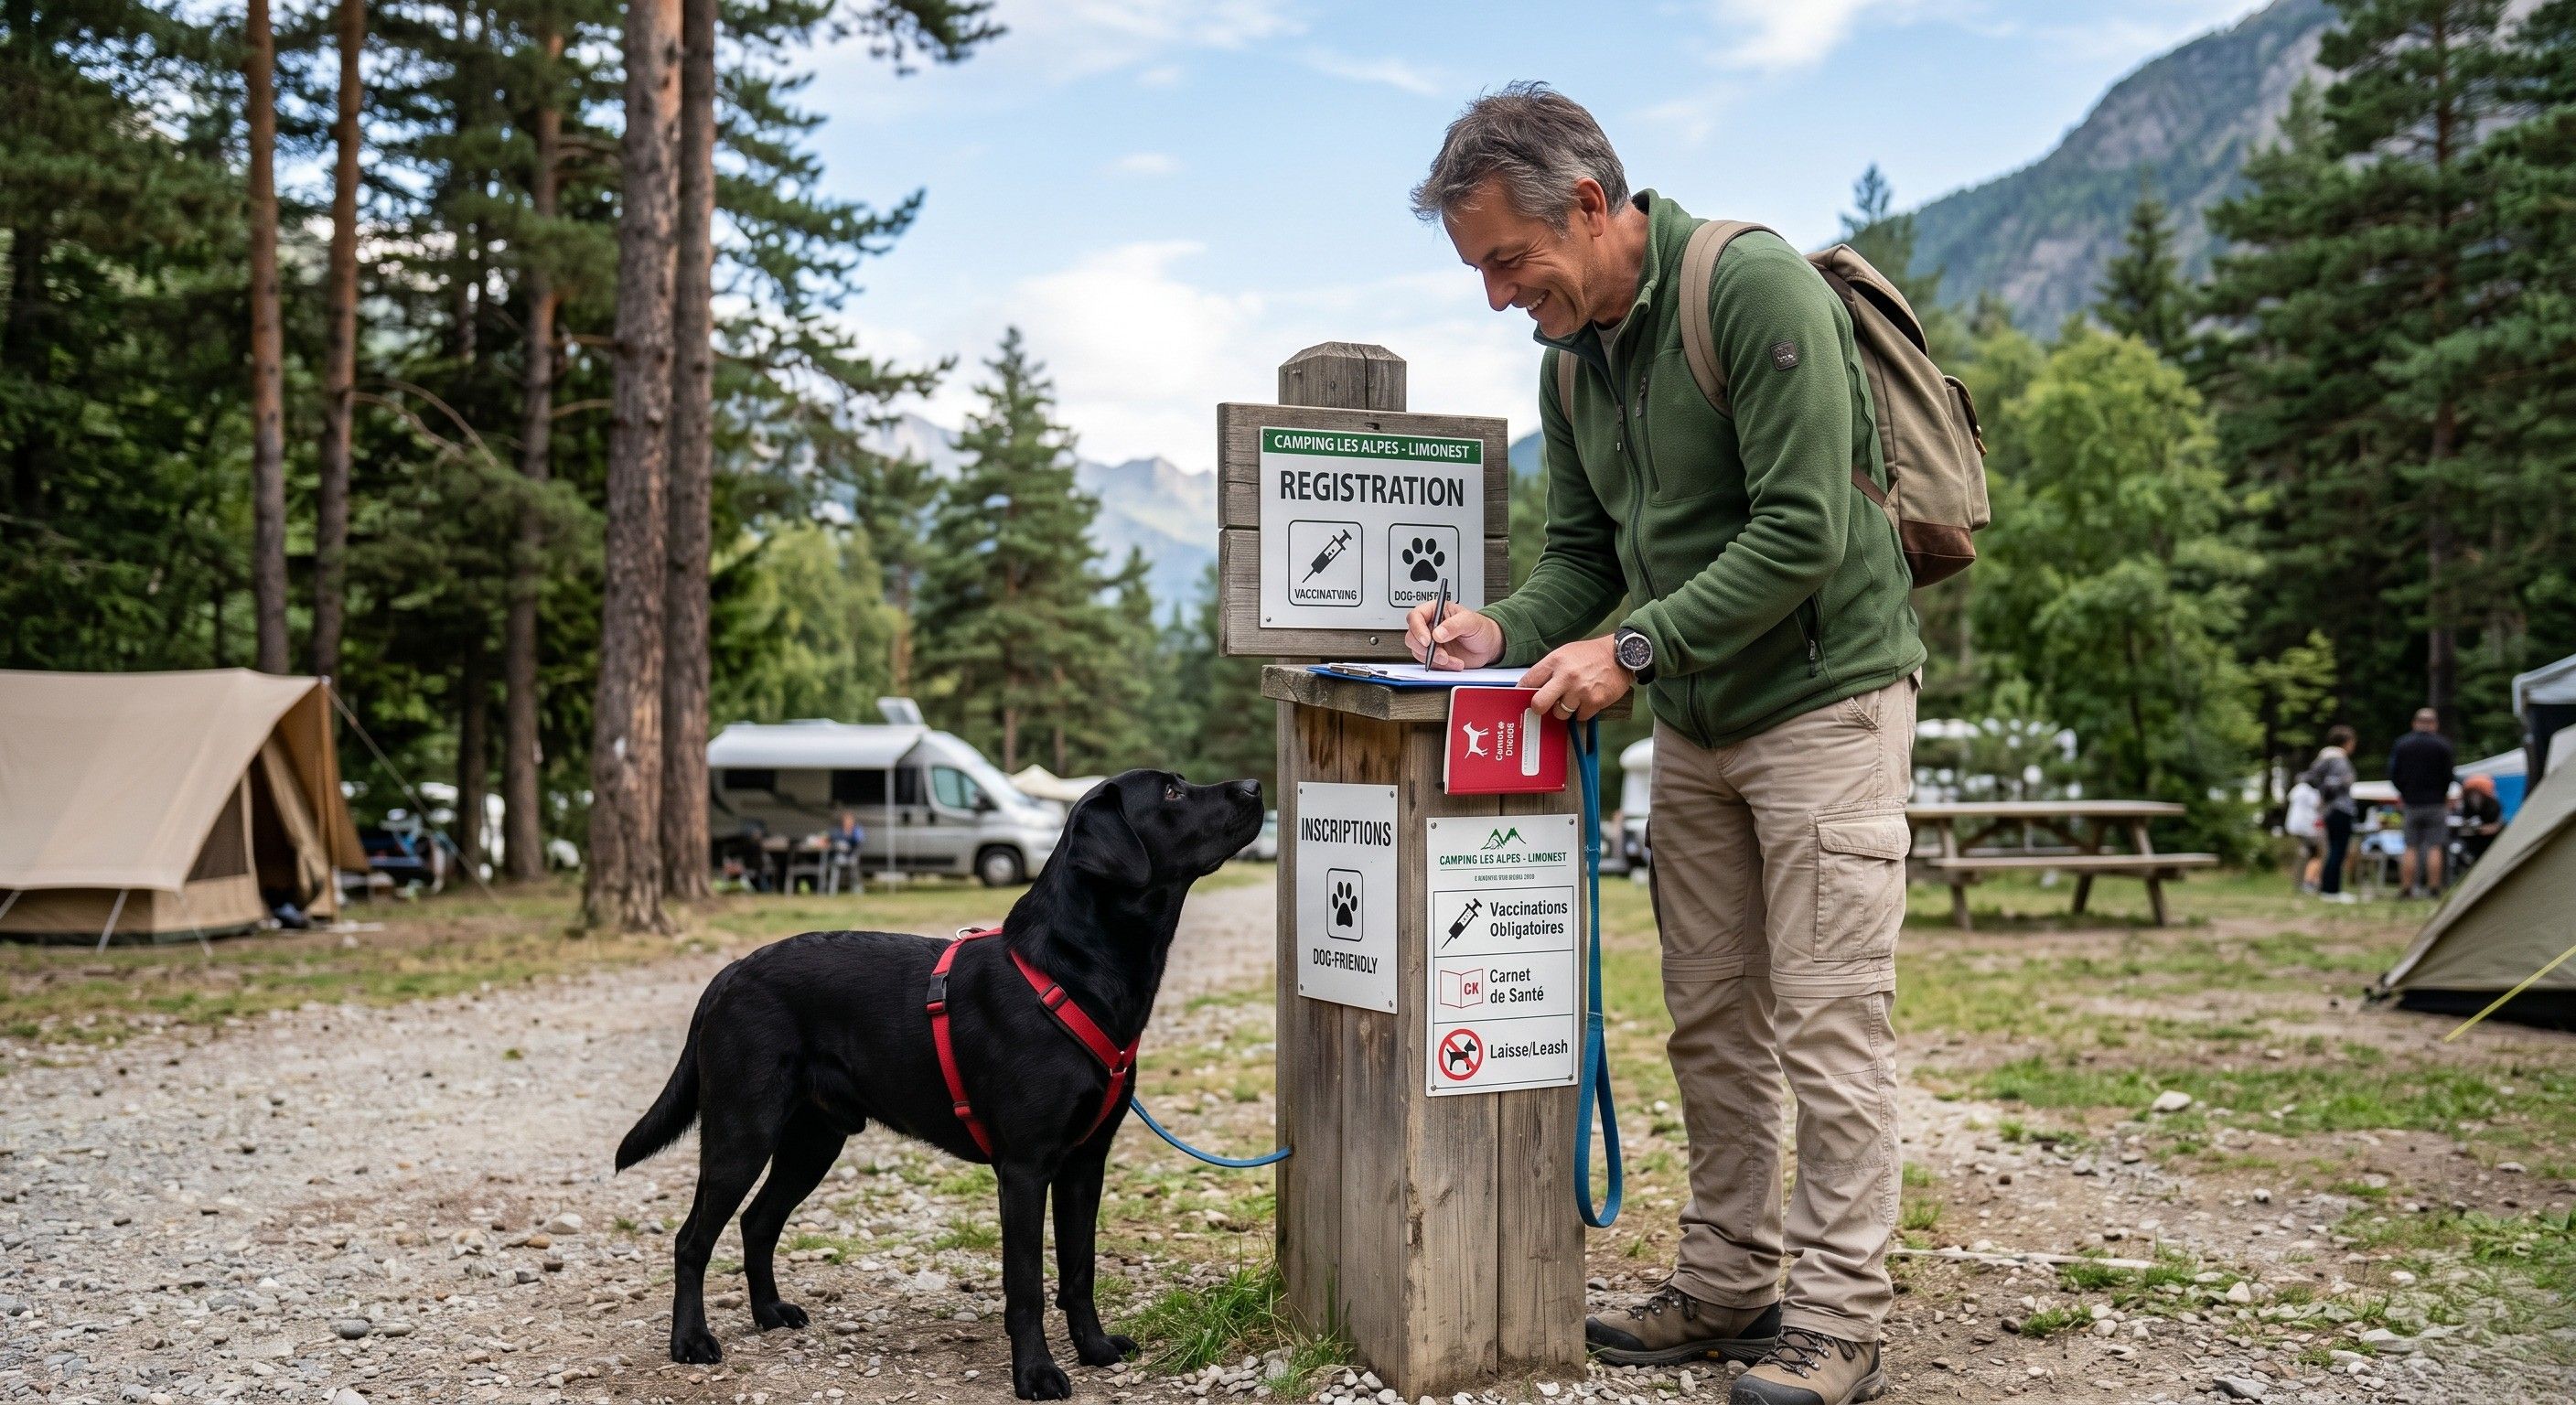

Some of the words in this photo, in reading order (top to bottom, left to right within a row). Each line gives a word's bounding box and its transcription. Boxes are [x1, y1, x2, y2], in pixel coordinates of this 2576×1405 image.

[1274, 434, 1335, 452] CAMPING
[1337, 437, 1358, 454] LES
[1360, 439, 1399, 455] ALPES
[1409, 441, 1470, 459] LIMONEST
[1280, 470, 1464, 508] REGISTRATION
[1301, 817, 1391, 847] INSCRIPTIONS
[1439, 853, 1478, 865] CAMPING
[1479, 853, 1494, 864] LES
[1496, 853, 1521, 864] ALPES
[1528, 852, 1567, 863] LIMONEST
[1489, 900, 1568, 917] Vaccinations
[1489, 920, 1564, 939] Obligatoires
[1313, 948, 1378, 974] DOG-FRIENDLY
[1489, 967, 1530, 983] Carnet
[1464, 981, 1479, 995] CK
[1489, 988, 1505, 1003] de
[1508, 985, 1544, 1003] Santé
[1489, 1039, 1568, 1059] Laisse/Leash
